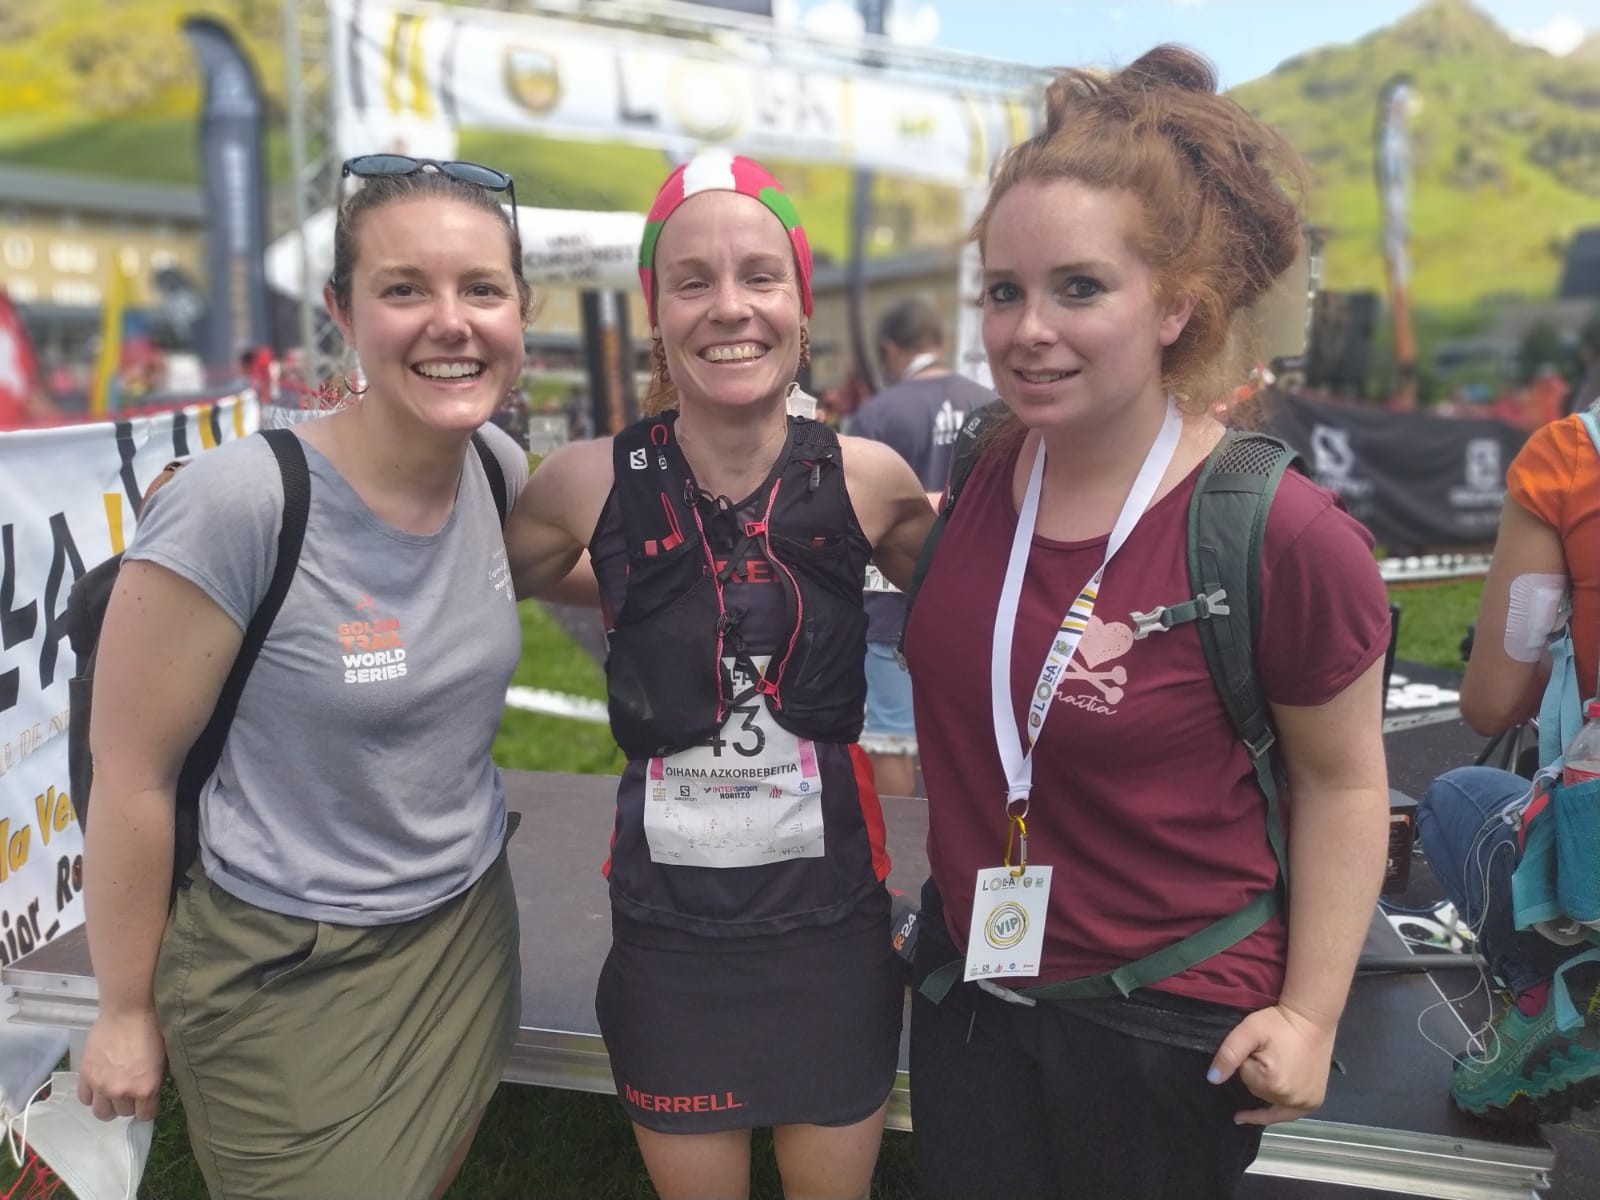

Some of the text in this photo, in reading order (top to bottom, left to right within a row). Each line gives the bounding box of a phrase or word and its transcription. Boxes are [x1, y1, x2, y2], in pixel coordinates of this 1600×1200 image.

[342, 648, 406, 669] WORLD
[343, 662, 408, 684] SERIES
[665, 763, 798, 779] OIHANA AZKORBEBEITIA
[996, 916, 1020, 936] VIP
[625, 1083, 743, 1113] MERRELL
